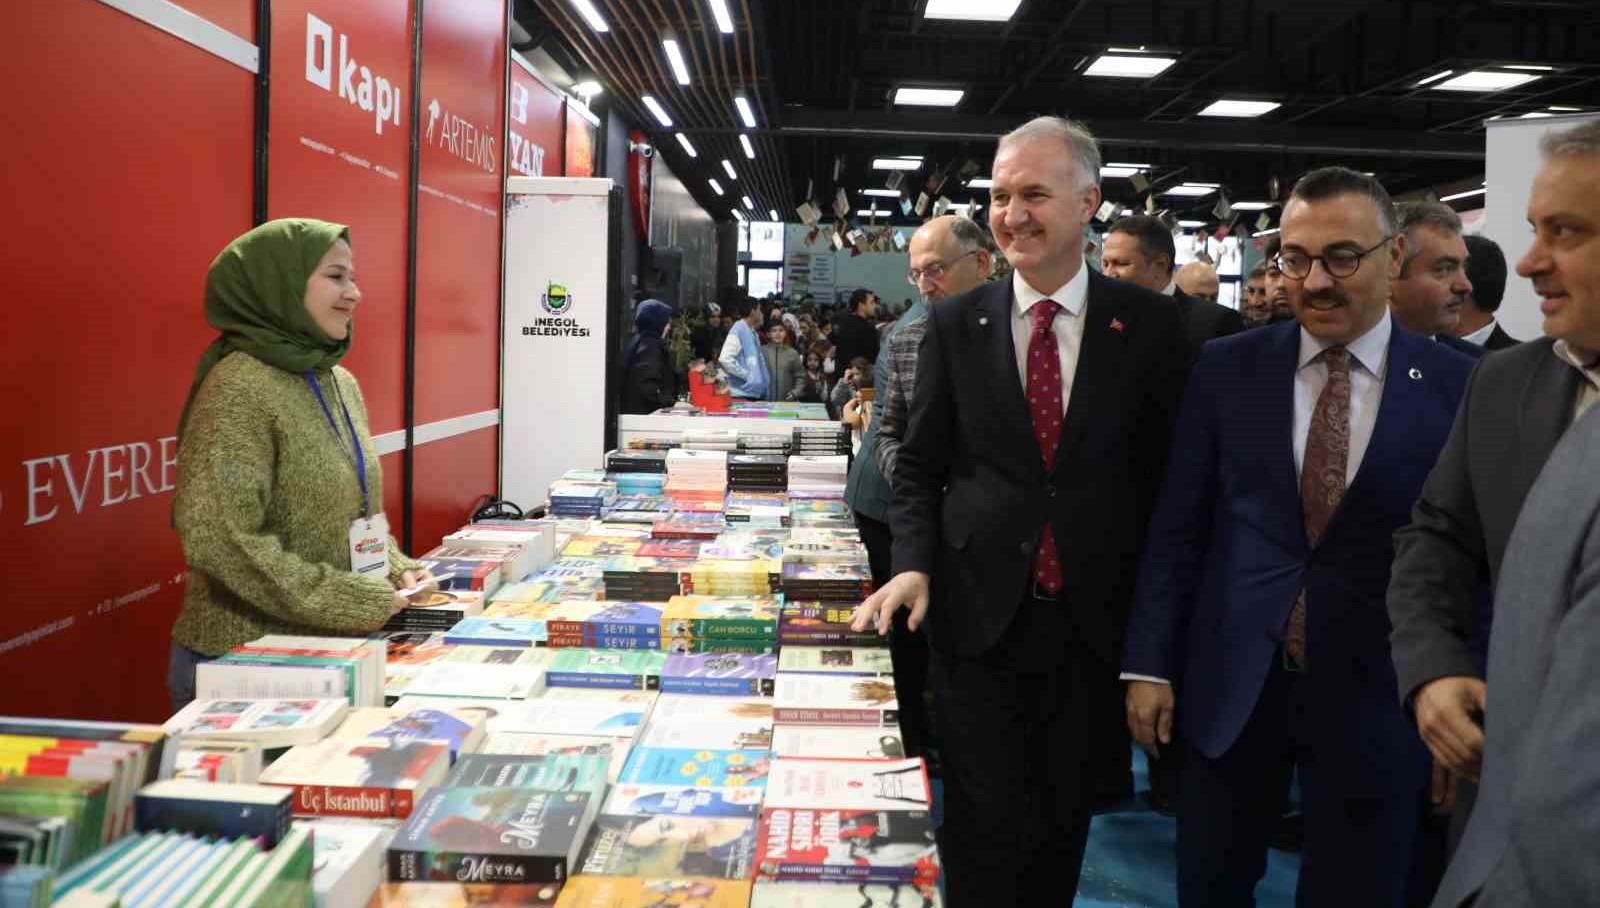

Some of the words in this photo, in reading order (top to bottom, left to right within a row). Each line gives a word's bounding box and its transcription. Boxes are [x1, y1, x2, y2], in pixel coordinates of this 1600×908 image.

[339, 33, 400, 135] kapı
[439, 109, 496, 173] ARTEMİS
[521, 327, 590, 337] BELEDİYESİ
[301, 786, 319, 812] Üç
[324, 787, 385, 812] İstanbul
